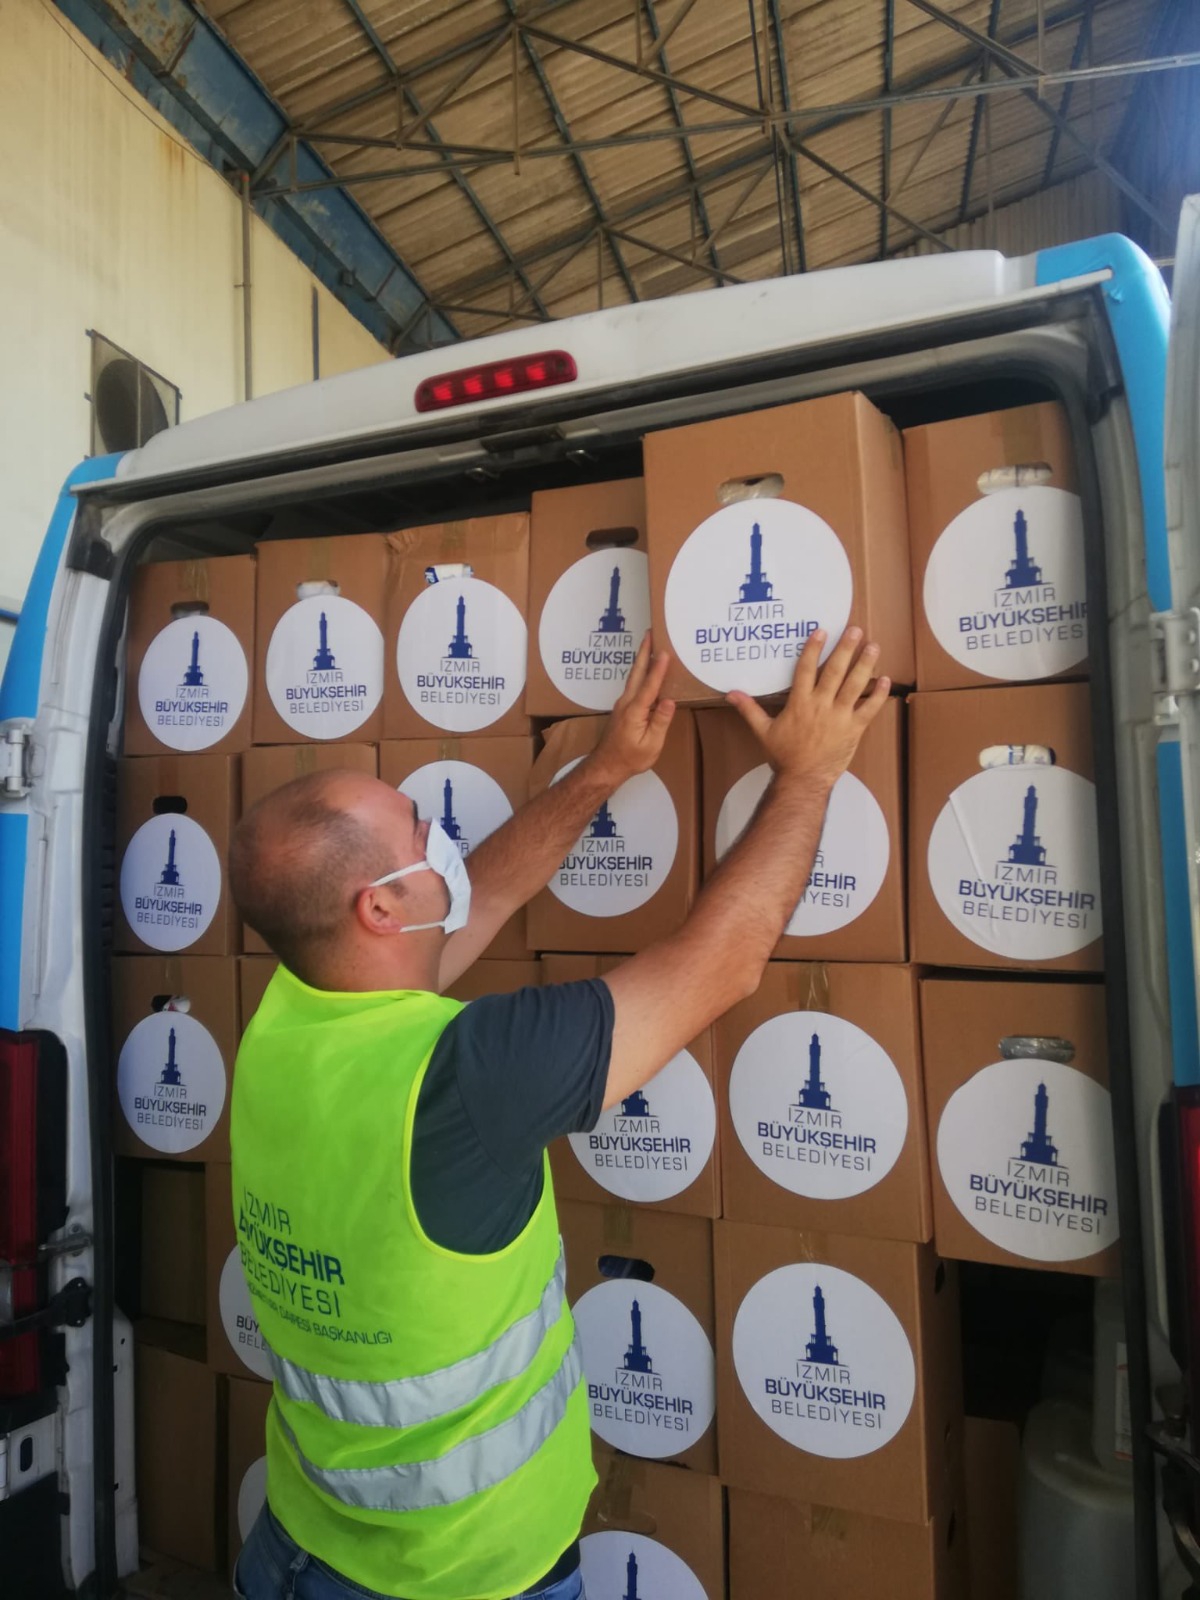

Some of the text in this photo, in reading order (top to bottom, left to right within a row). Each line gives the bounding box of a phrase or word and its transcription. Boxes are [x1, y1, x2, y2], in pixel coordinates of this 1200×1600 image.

[994, 587, 1056, 608] İZMİR
[728, 604, 784, 622] İZMİR
[588, 633, 633, 647] İZMİR
[966, 624, 1083, 650] BELEDİYES
[561, 648, 637, 665] BÜYÜKŞE
[700, 642, 805, 663] BELEDİYES
[440, 660, 480, 673] İZMİR
[564, 667, 628, 680] BELEDİY
[306, 671, 343, 684] İZMİR
[417, 672, 505, 690] BÜYÜKŞEHİR
[175, 687, 209, 699] İZMİR
[286, 684, 367, 700] BÜYÜKŞEHİR
[420, 690, 500, 705] BELEDİYESİ
[155, 698, 228, 714] BÜYÜKŞEHİR
[290, 700, 364, 714] BELEDİYESİ
[157, 714, 224, 727] BELEDİYESİ
[581, 839, 625, 853] İZMİR
[560, 873, 648, 887] BELEDİYESİ
[994, 864, 1058, 885] İZMİR
[153, 884, 185, 898] İZMİR
[958, 879, 1096, 910] BÜYÜKŞEHİR
[135, 895, 202, 915] BÜYÜKŞEHİR
[137, 912, 198, 929] BELEDİYESİ
[962, 901, 1088, 930] BELEDİYESİ
[153, 1084, 187, 1099] İZMİR
[134, 1096, 207, 1117] BÜYÜKŞEHİR
[137, 1112, 203, 1131] BELEDİYESİ
[614, 1118, 661, 1133] İZMİR
[788, 1107, 842, 1129] İZMİR
[589, 1133, 691, 1153] BÜYÜKŞEHİR
[758, 1121, 876, 1154] BÜYÜKŞEHİR
[595, 1153, 688, 1171] BELEDİYESİ
[763, 1142, 871, 1172] BELEDİYESİ
[1007, 1160, 1070, 1187] İZMİR
[970, 1174, 1108, 1216] BÜYÜKŞEHİR
[975, 1196, 1101, 1235] BELEDİYESİ
[615, 1370, 663, 1391] İZMİR
[796, 1363, 850, 1385] İZMİR
[588, 1383, 693, 1415] BÜYÜKŞEHİR
[765, 1377, 886, 1410] BÜYÜKŞEHİR
[593, 1404, 689, 1432] BELEDİYESİ
[771, 1400, 881, 1429] BELEDİYESİ
